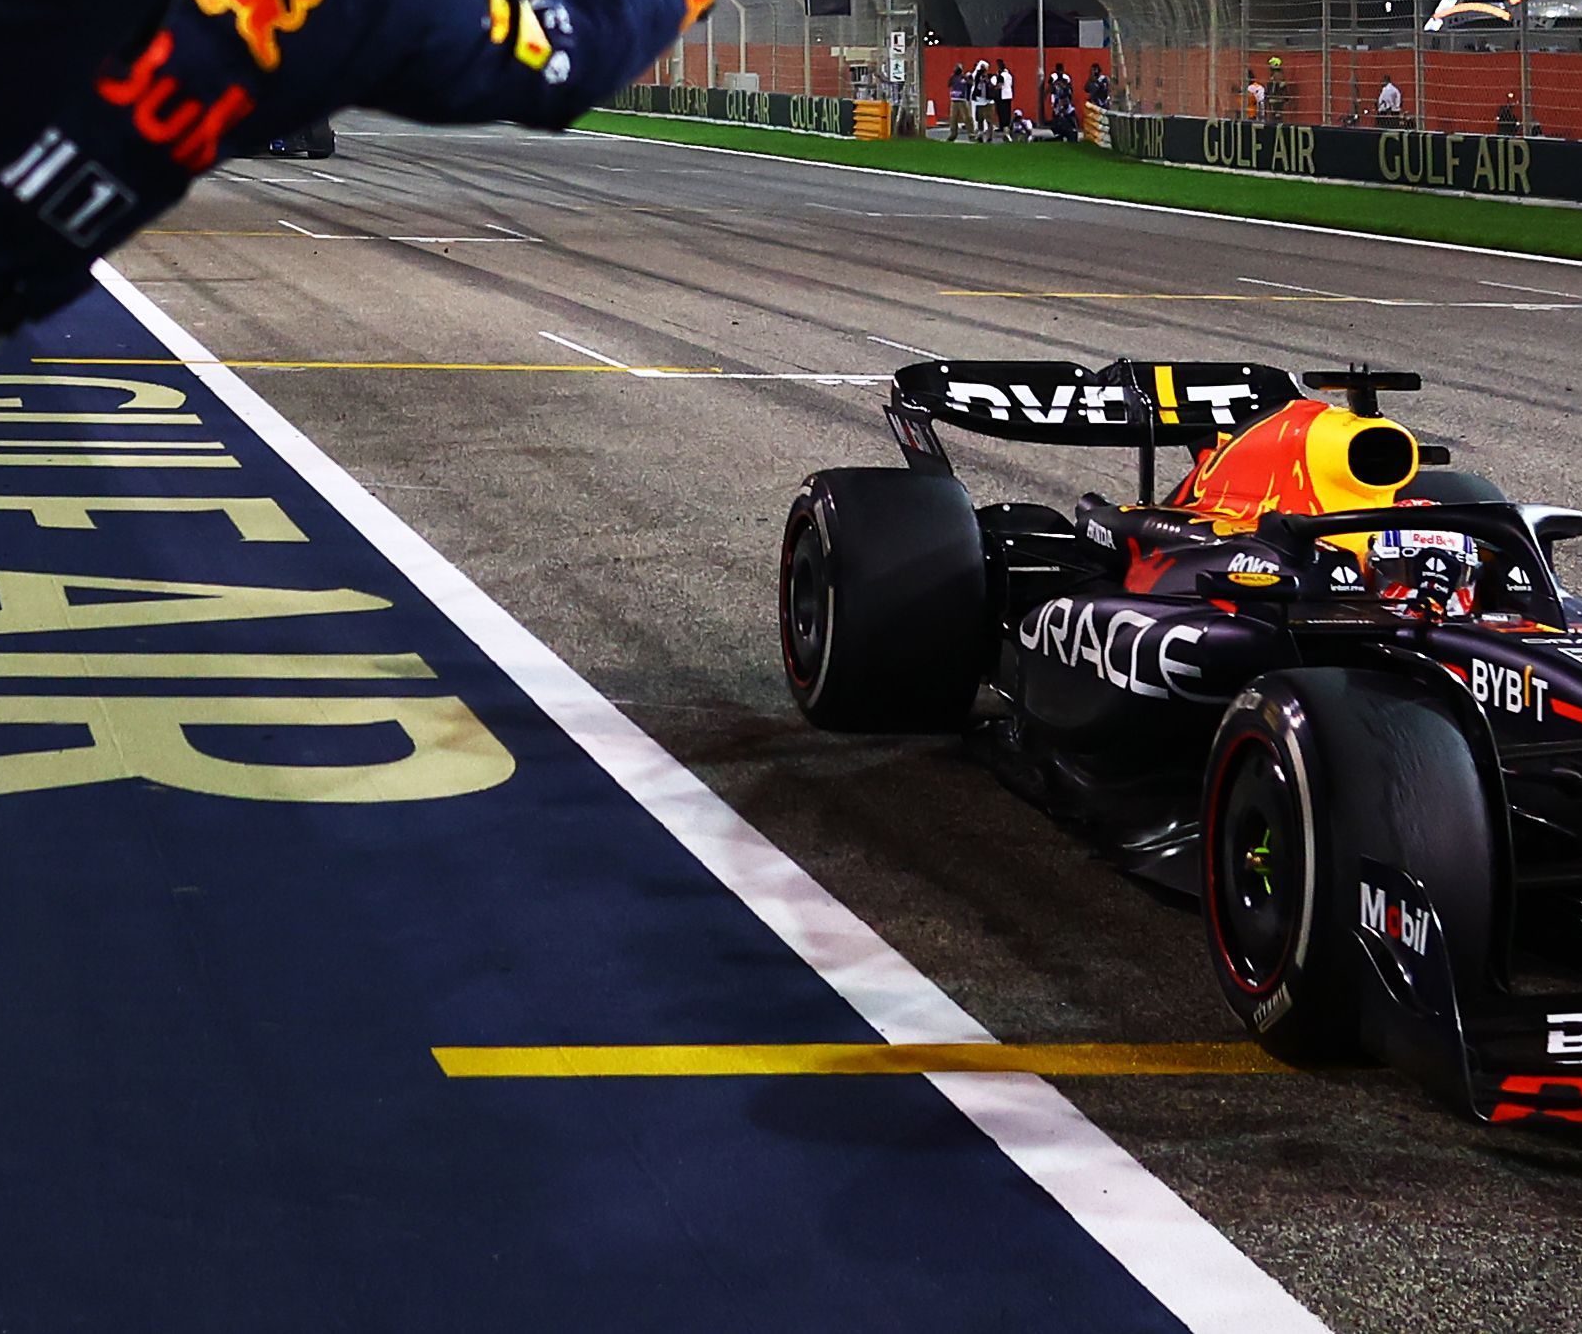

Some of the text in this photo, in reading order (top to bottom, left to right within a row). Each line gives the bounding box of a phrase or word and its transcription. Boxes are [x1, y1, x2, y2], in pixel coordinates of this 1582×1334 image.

[726, 89, 770, 124] GULF AIR
[790, 95, 841, 133] GULF AIR
[1203, 118, 1316, 174] GULF AIR
[1378, 131, 1531, 195] GULF AIR
[1472, 658, 1549, 722] BYBIT
[1359, 881, 1431, 956] Mobil
